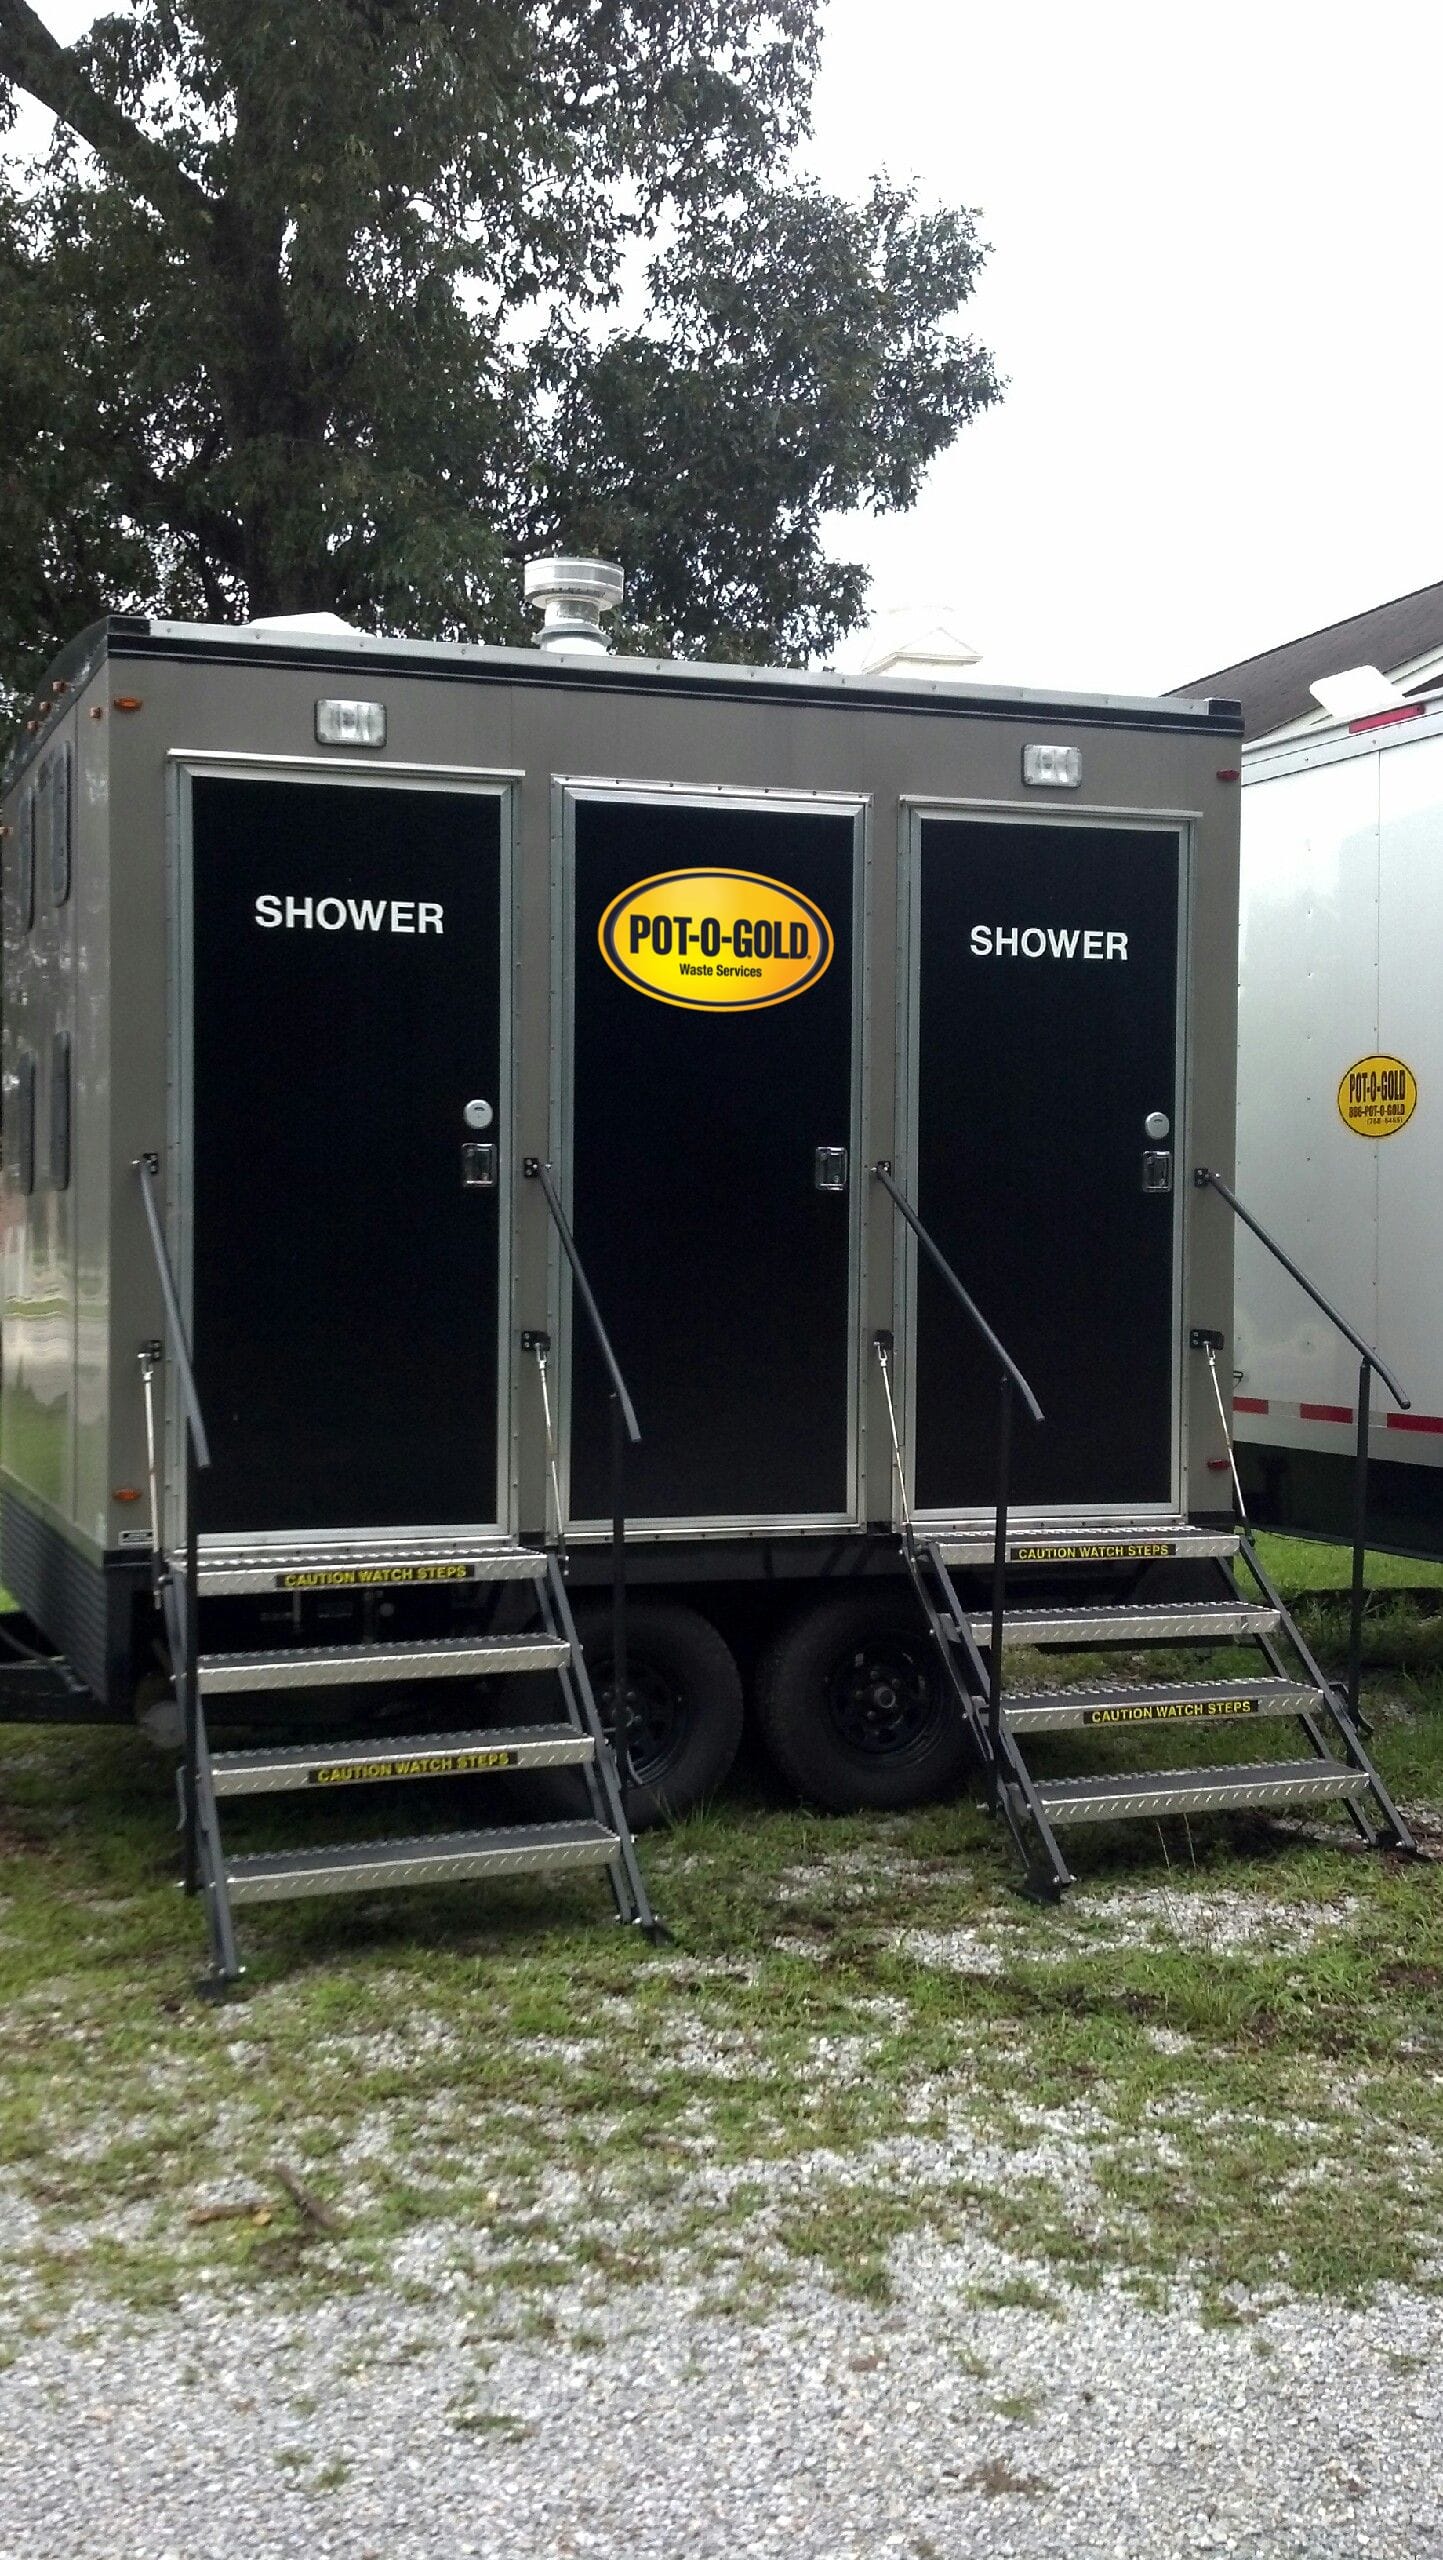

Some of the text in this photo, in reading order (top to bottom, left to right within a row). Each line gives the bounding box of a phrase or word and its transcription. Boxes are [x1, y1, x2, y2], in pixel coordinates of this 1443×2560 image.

[255, 895, 444, 934] SHOWER
[630, 914, 810, 960] POT-O-GOLD
[970, 925, 1128, 961] SHOWER
[679, 963, 762, 978] Waste Services
[1349, 1070, 1406, 1103] POT-O-GOLD
[1018, 1544, 1169, 1560] CAUTION WATCH STEPS
[284, 1565, 467, 1587] CAUTION WATCH STEPS
[1091, 1701, 1251, 1723] CAUTION WATCH STEPS
[317, 1752, 509, 1783] CAUTION WATCH STEPS
